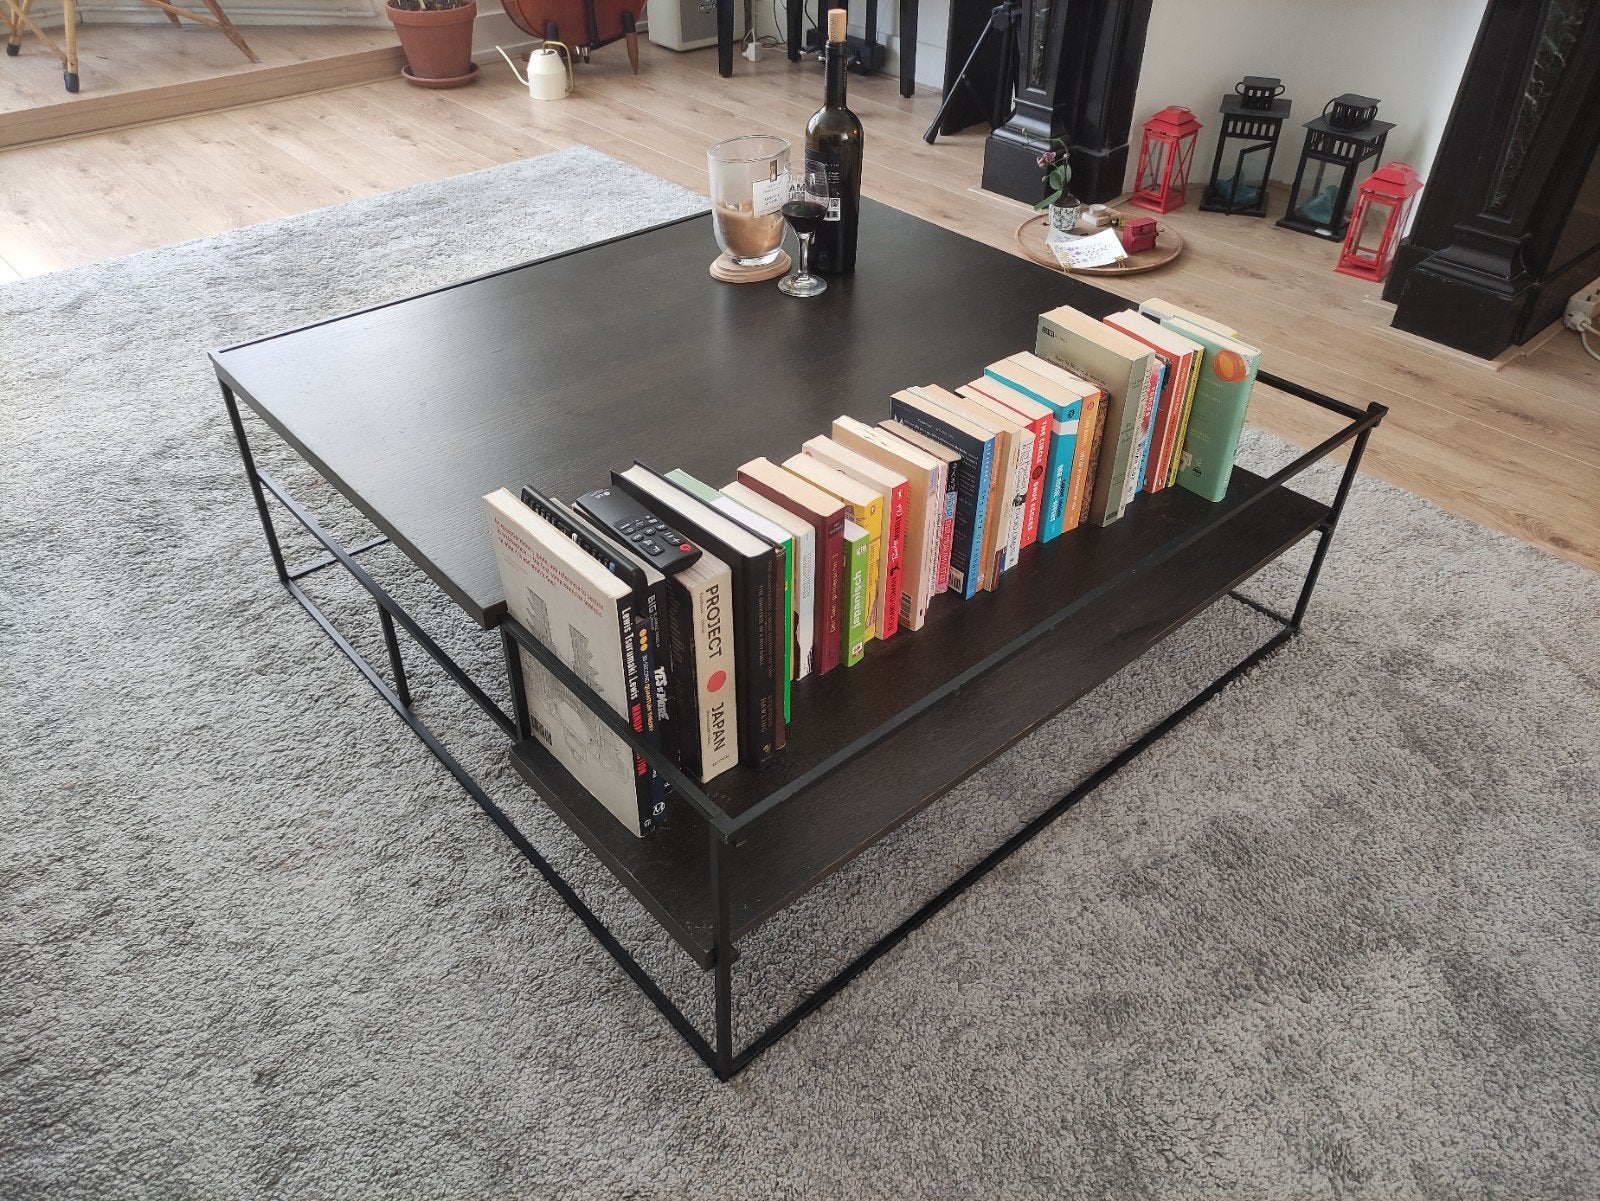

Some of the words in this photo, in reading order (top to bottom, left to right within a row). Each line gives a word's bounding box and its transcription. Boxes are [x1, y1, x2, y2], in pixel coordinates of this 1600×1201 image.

[1036, 439, 1045, 464] CIRCLE
[648, 594, 657, 613] BIG
[851, 570, 862, 629] japanisch
[621, 606, 633, 634] Lewis
[705, 583, 722, 659] PROJECT
[624, 633, 638, 676] Tsurumaki
[629, 675, 640, 700] Lewis
[654, 665, 668, 686] YES
[711, 701, 726, 752] JAPAN
